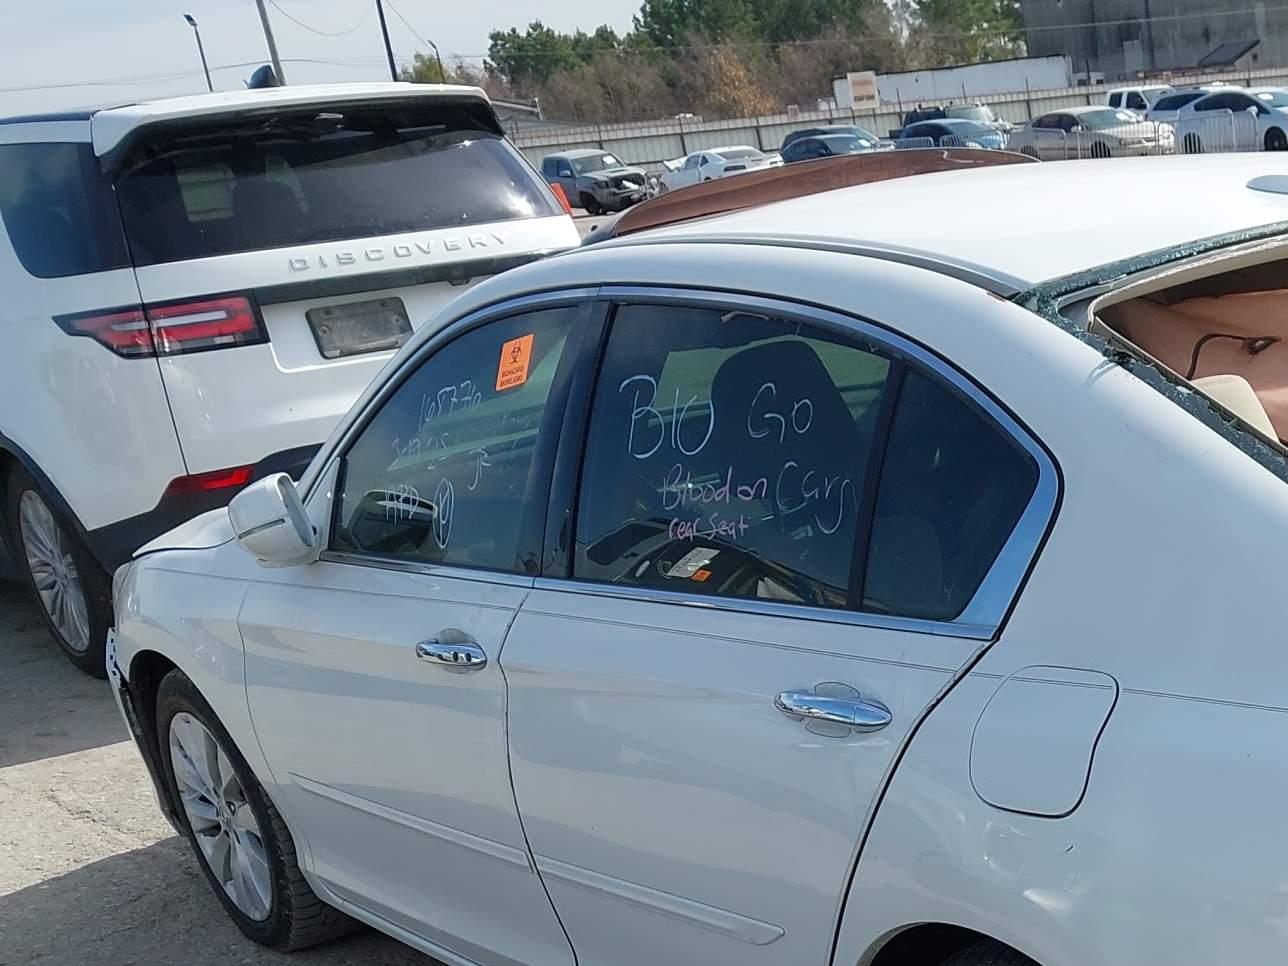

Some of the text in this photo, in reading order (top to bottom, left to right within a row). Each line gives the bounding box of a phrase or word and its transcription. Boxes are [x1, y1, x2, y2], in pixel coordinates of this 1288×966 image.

[288, 232, 508, 272] DISCOVERY
[660, 464, 768, 510] Blood on
